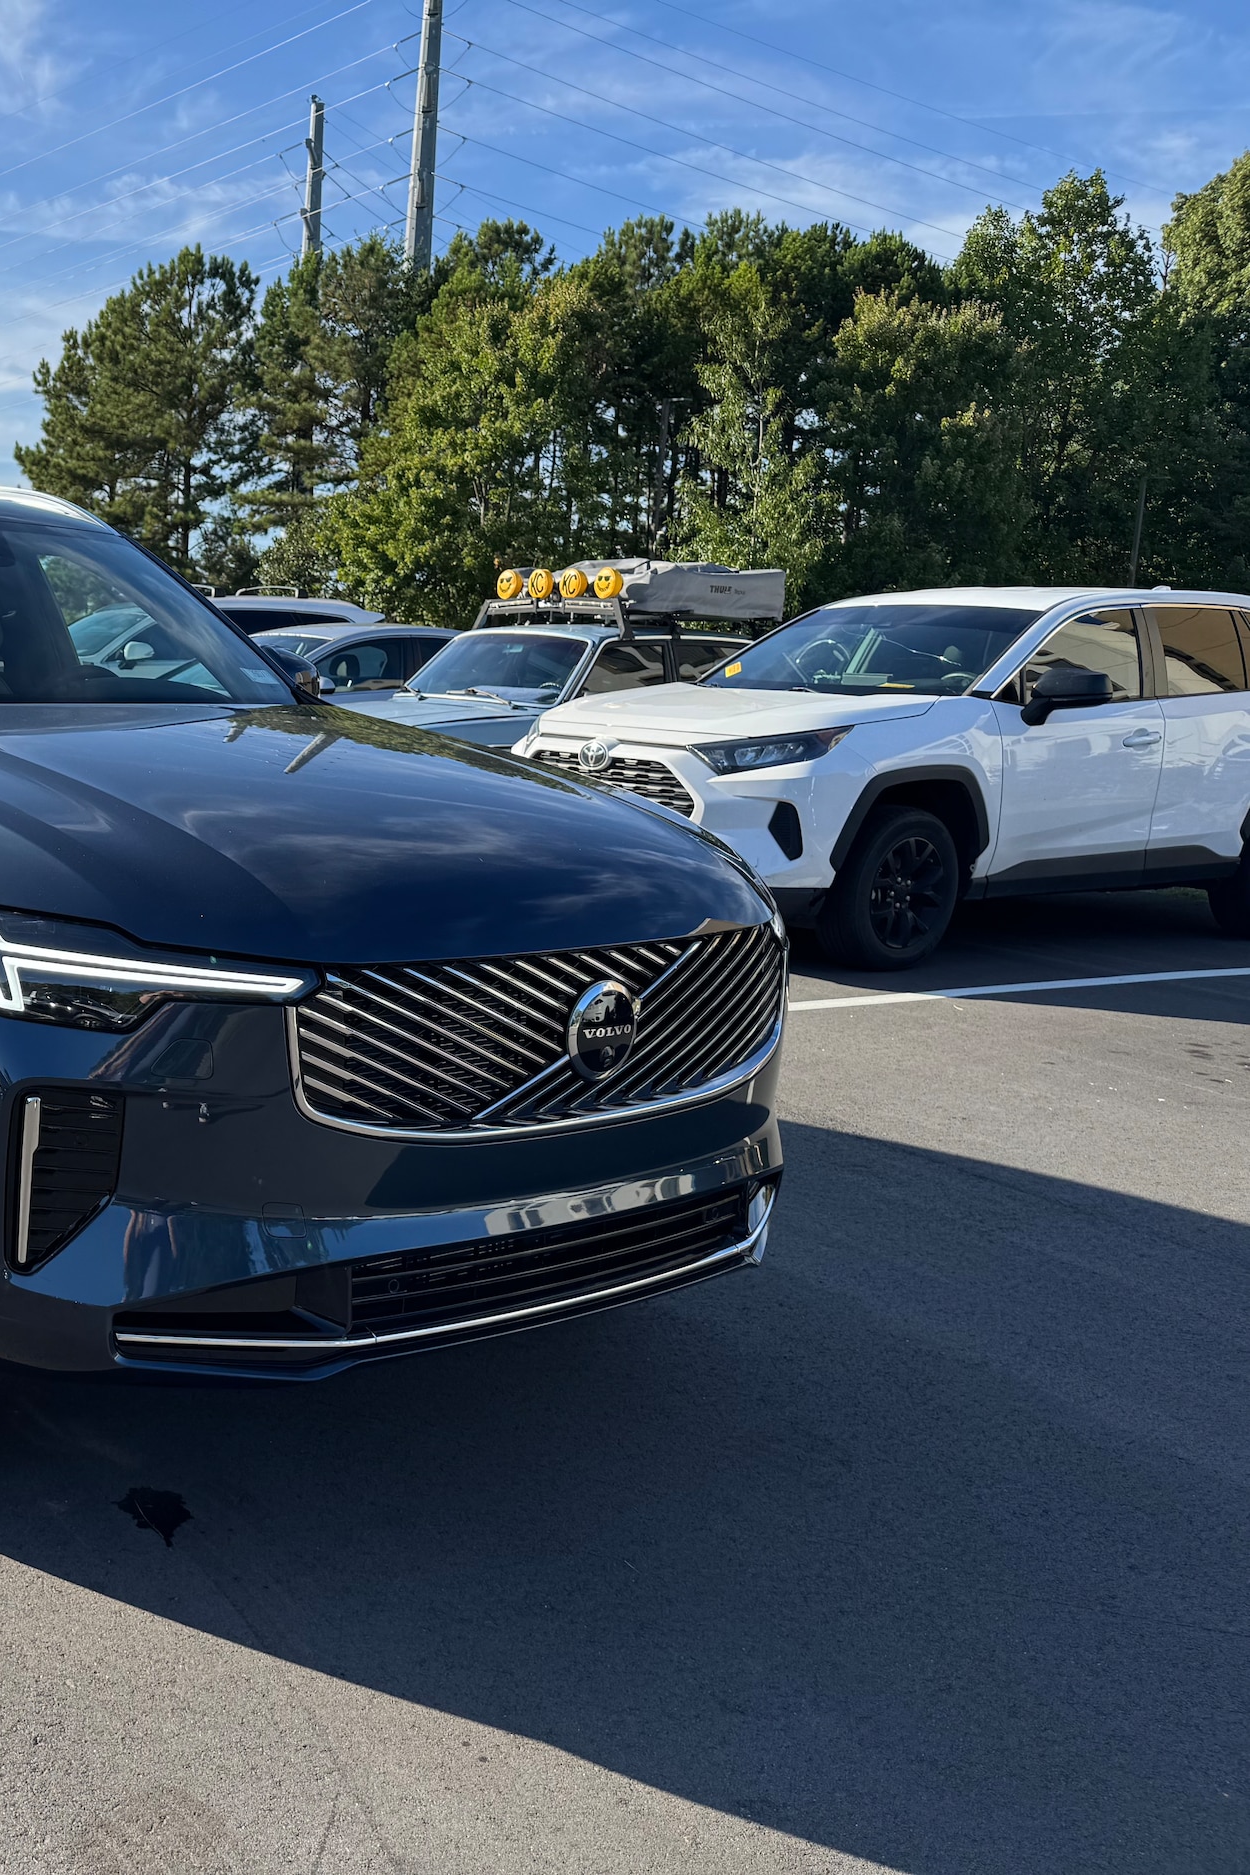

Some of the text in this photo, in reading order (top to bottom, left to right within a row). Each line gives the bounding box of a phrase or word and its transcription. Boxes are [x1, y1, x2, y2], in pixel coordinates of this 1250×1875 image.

[530, 572, 544, 596] KC
[562, 573, 578, 596] KC
[710, 585, 732, 594] THULE
[583, 1024, 631, 1039] VOLVO
